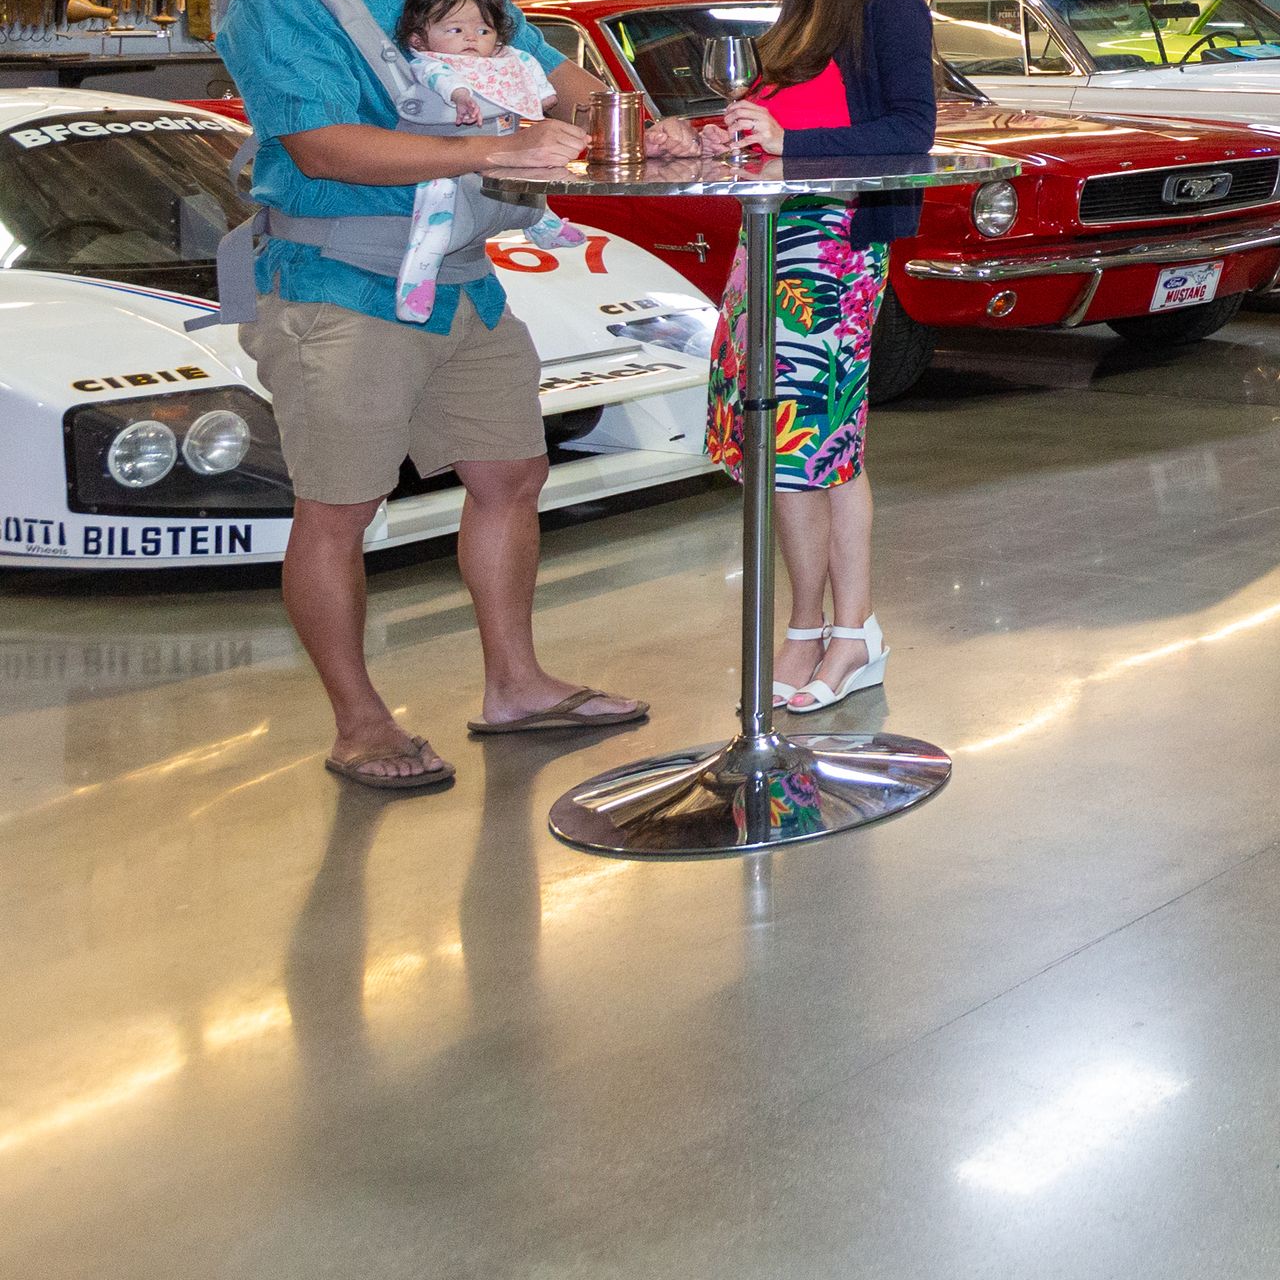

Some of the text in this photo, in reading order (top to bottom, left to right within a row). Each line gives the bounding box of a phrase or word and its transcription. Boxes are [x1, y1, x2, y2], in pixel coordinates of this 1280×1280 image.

[9, 116, 240, 149] BFGoodrich
[485, 236, 611, 274] 67
[1165, 277, 1185, 288] Ford
[1165, 284, 1206, 303] MUSTANG
[0, 516, 252, 557] OTTI BILSTEIN
[26, 543, 69, 557] Wheels
